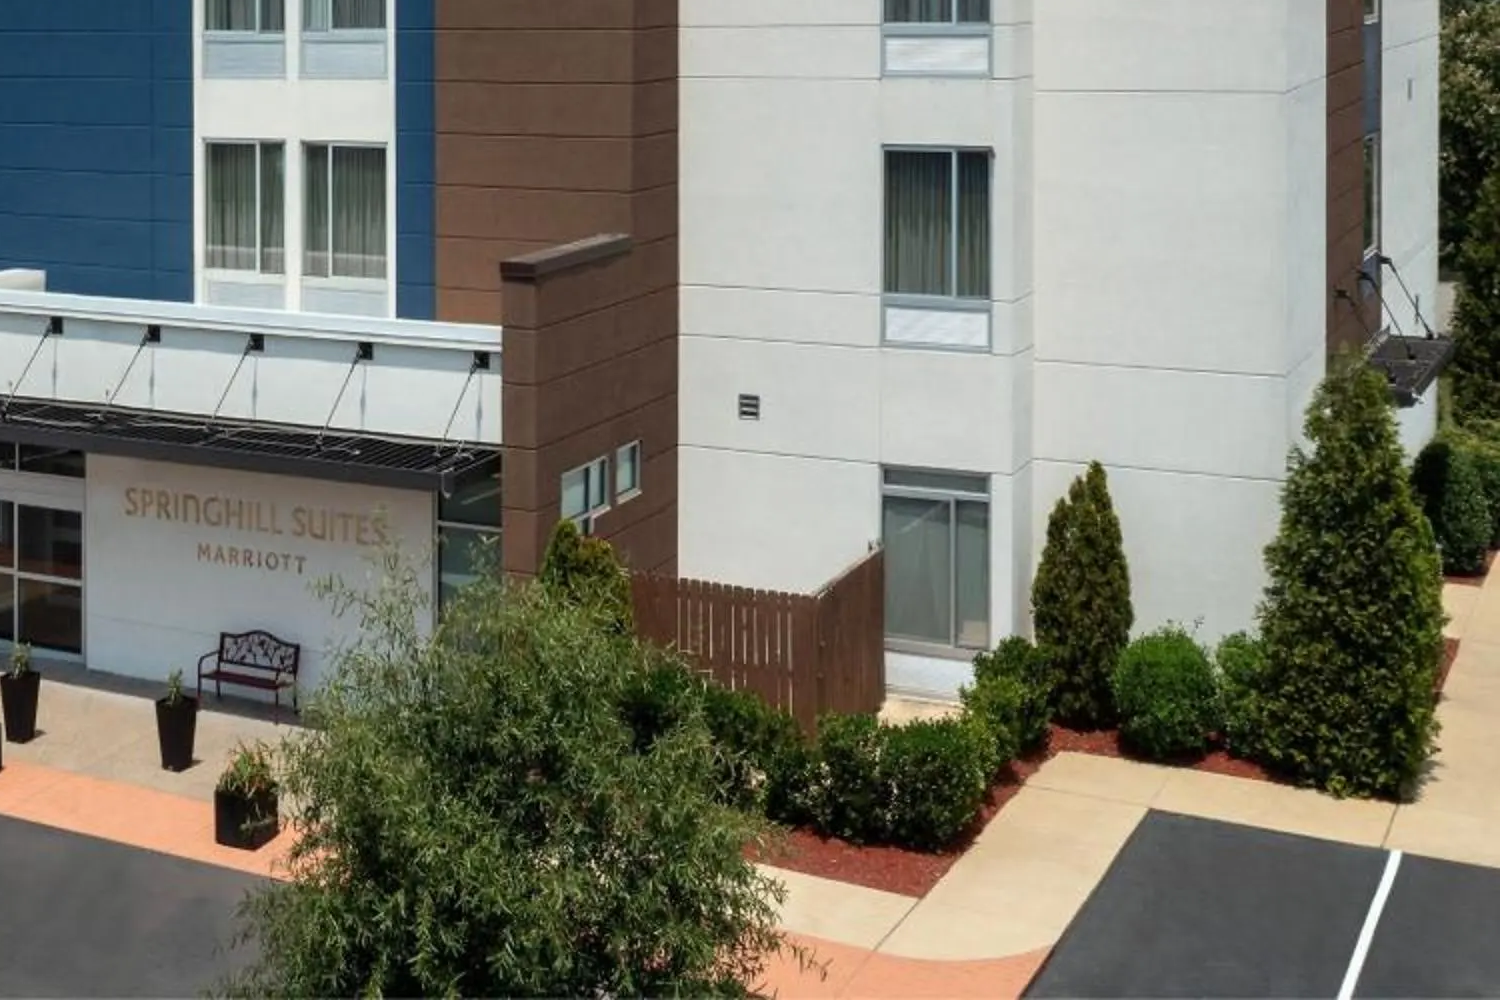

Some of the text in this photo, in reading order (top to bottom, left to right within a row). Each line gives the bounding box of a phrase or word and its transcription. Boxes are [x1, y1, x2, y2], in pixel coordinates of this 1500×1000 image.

[124, 487, 389, 547] SPRINGHILL SUITES
[197, 542, 307, 574] MARRIOTT
